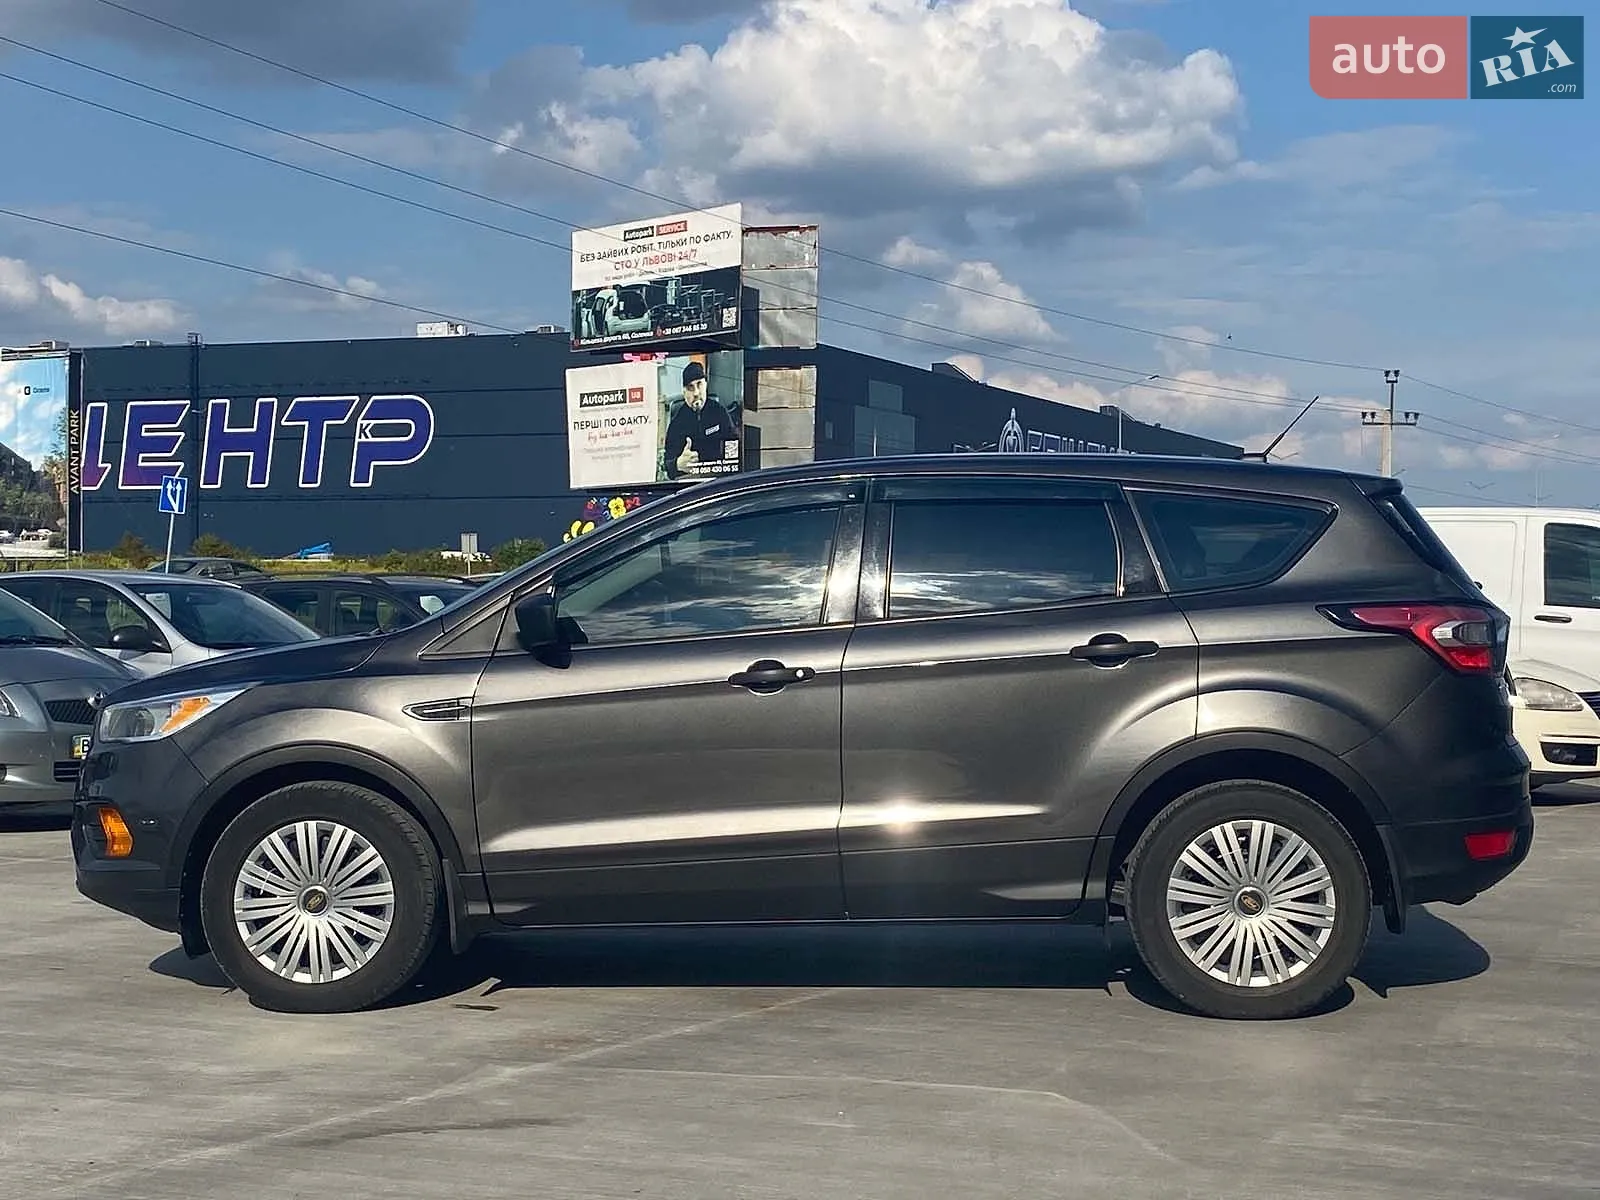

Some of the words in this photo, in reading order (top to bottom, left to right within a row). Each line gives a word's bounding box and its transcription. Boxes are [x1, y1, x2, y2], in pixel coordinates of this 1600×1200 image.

[624, 226, 652, 240] Autopark
[658, 221, 685, 234] SERVICE
[580, 252, 595, 263] БЕЗ
[596, 247, 629, 260] ЗАЙВИХ
[657, 238, 688, 250] ТІЛЬКИ
[689, 235, 702, 246] ПО
[614, 259, 632, 271] СТО
[634, 258, 639, 268] У
[641, 252, 676, 267] ЛЬВОВІ
[678, 248, 698, 261] 24/7
[582, 390, 624, 405] Autopark
[70, 409, 80, 445] PARK
[573, 419, 602, 431] ПЕРШІ
[604, 417, 618, 428] ПО
[70, 447, 80, 494] AVANT
